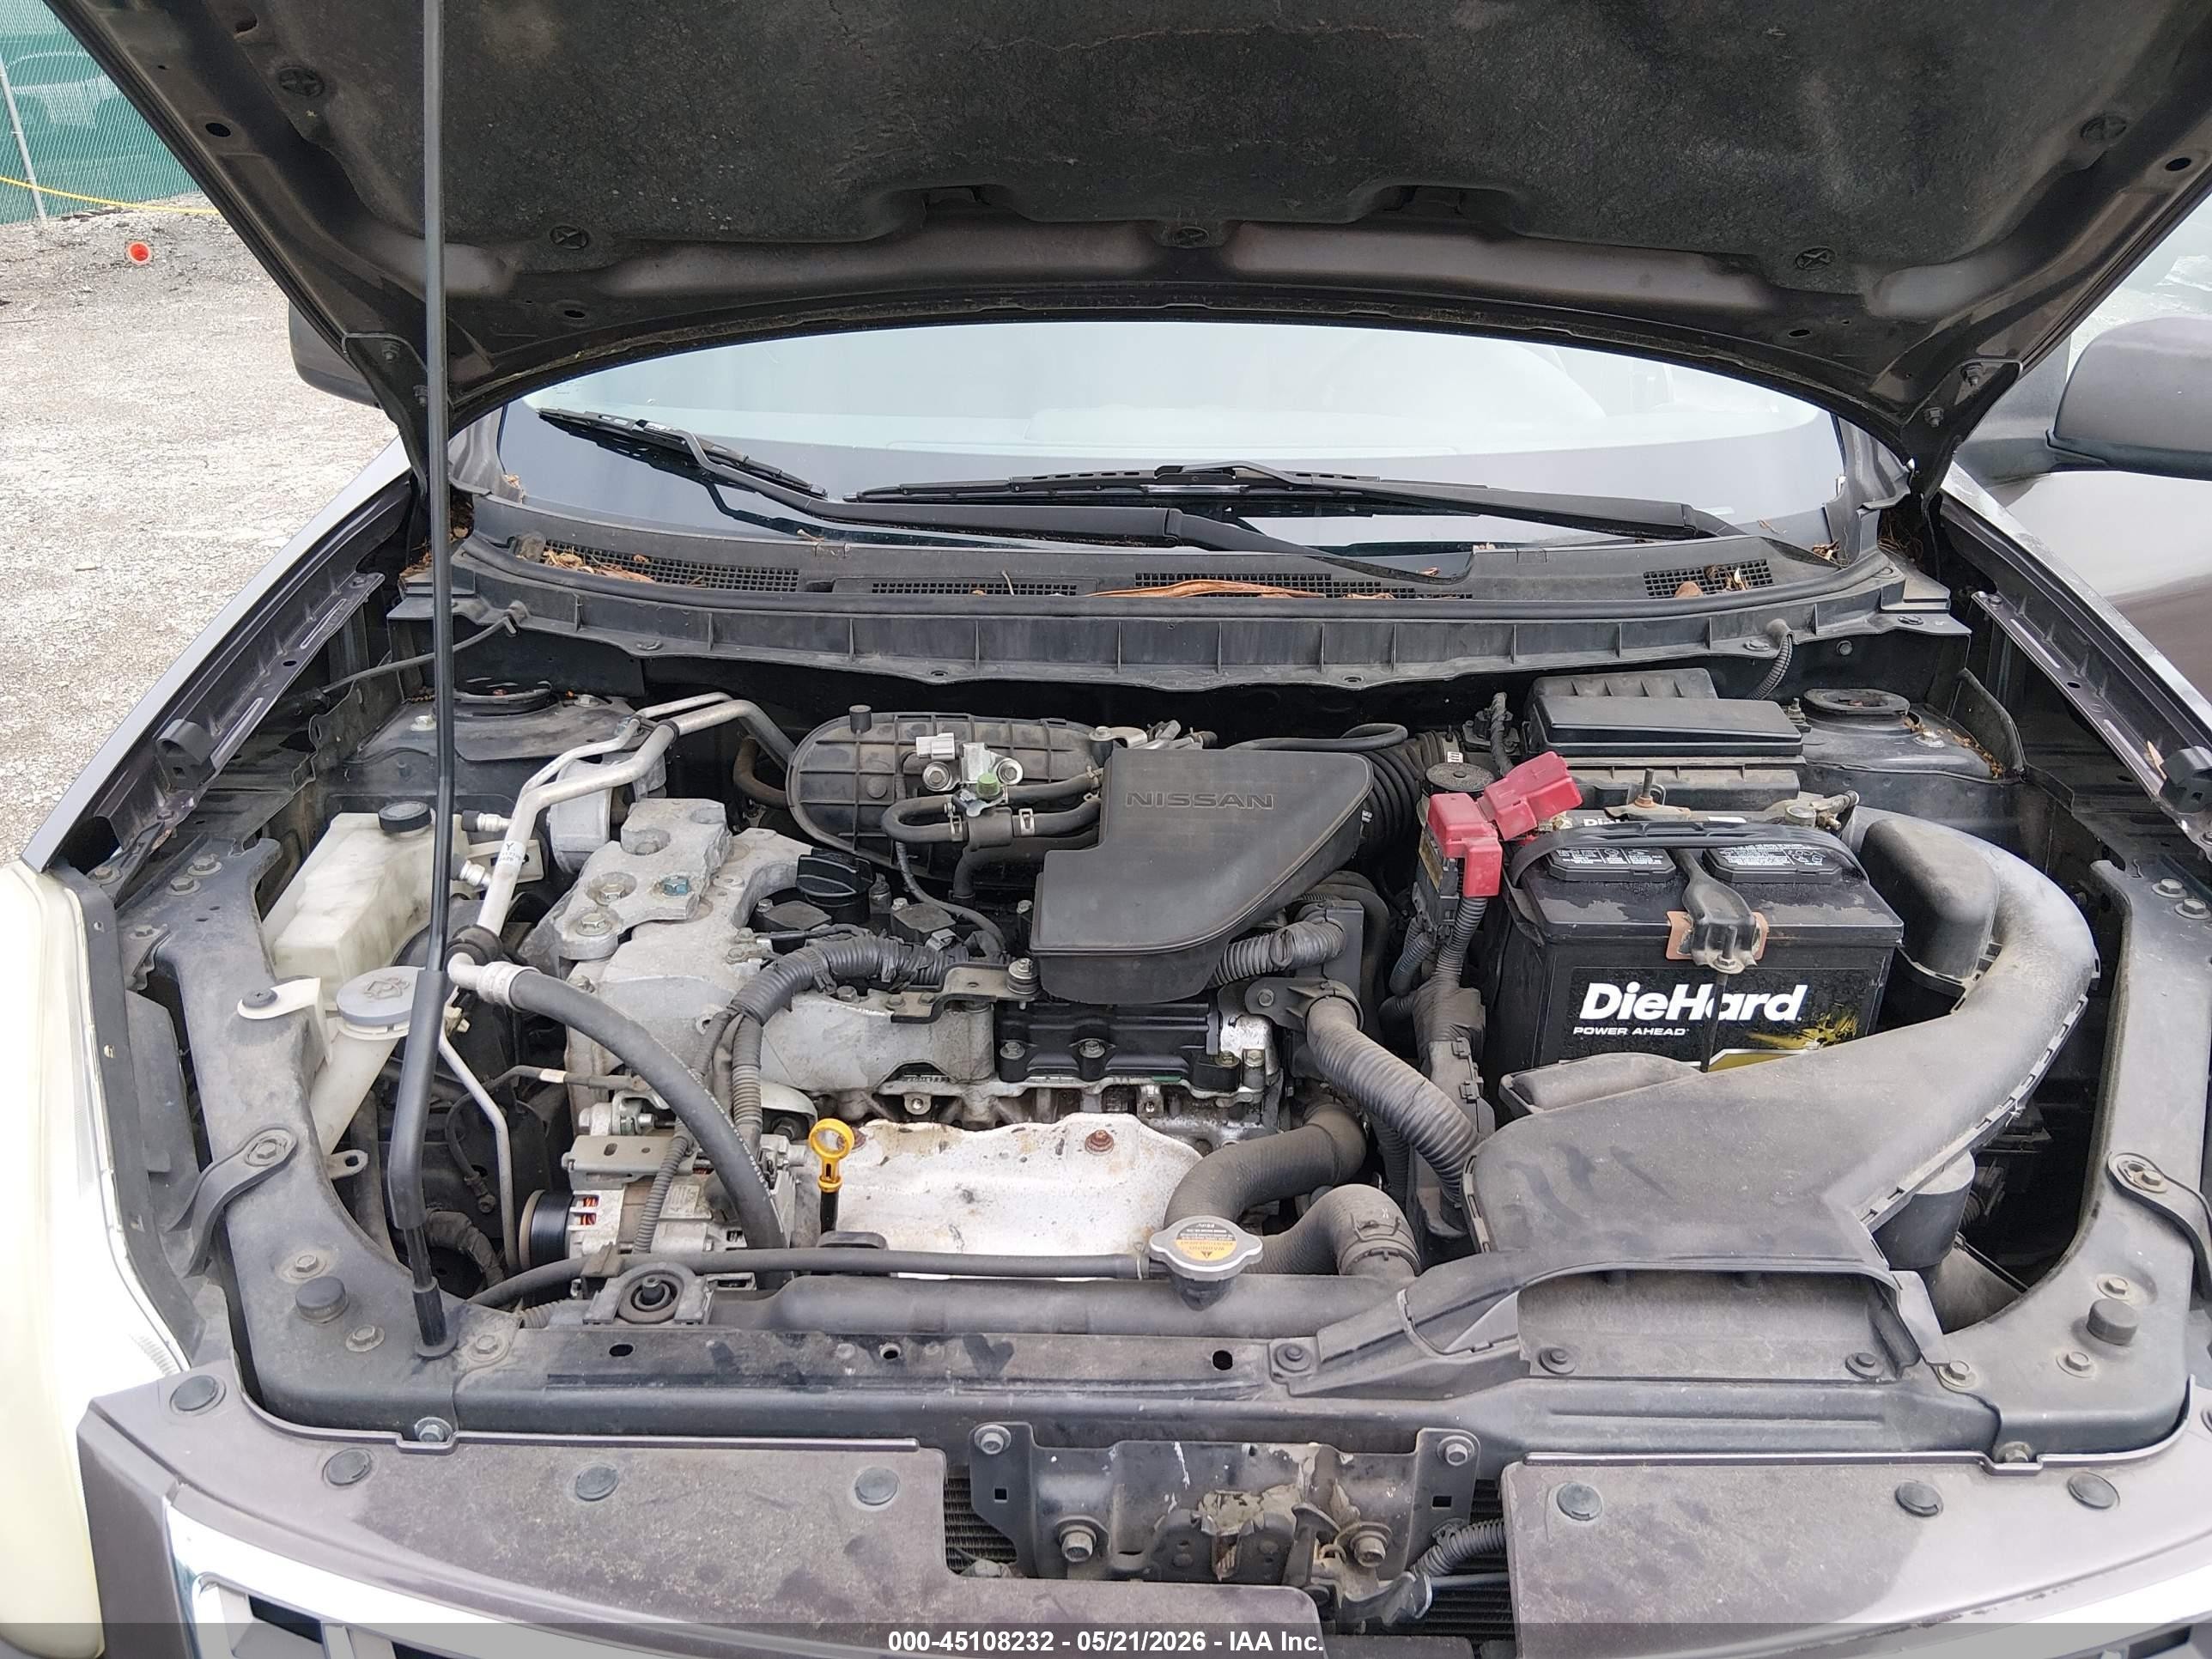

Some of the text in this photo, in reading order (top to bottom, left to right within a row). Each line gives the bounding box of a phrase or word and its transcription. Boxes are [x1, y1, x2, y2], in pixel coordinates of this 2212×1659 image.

[1127, 792, 1274, 810] NISSAN
[1579, 981, 1808, 1021] DieHard
[1572, 1026, 1686, 1036] POWER AHEAD
